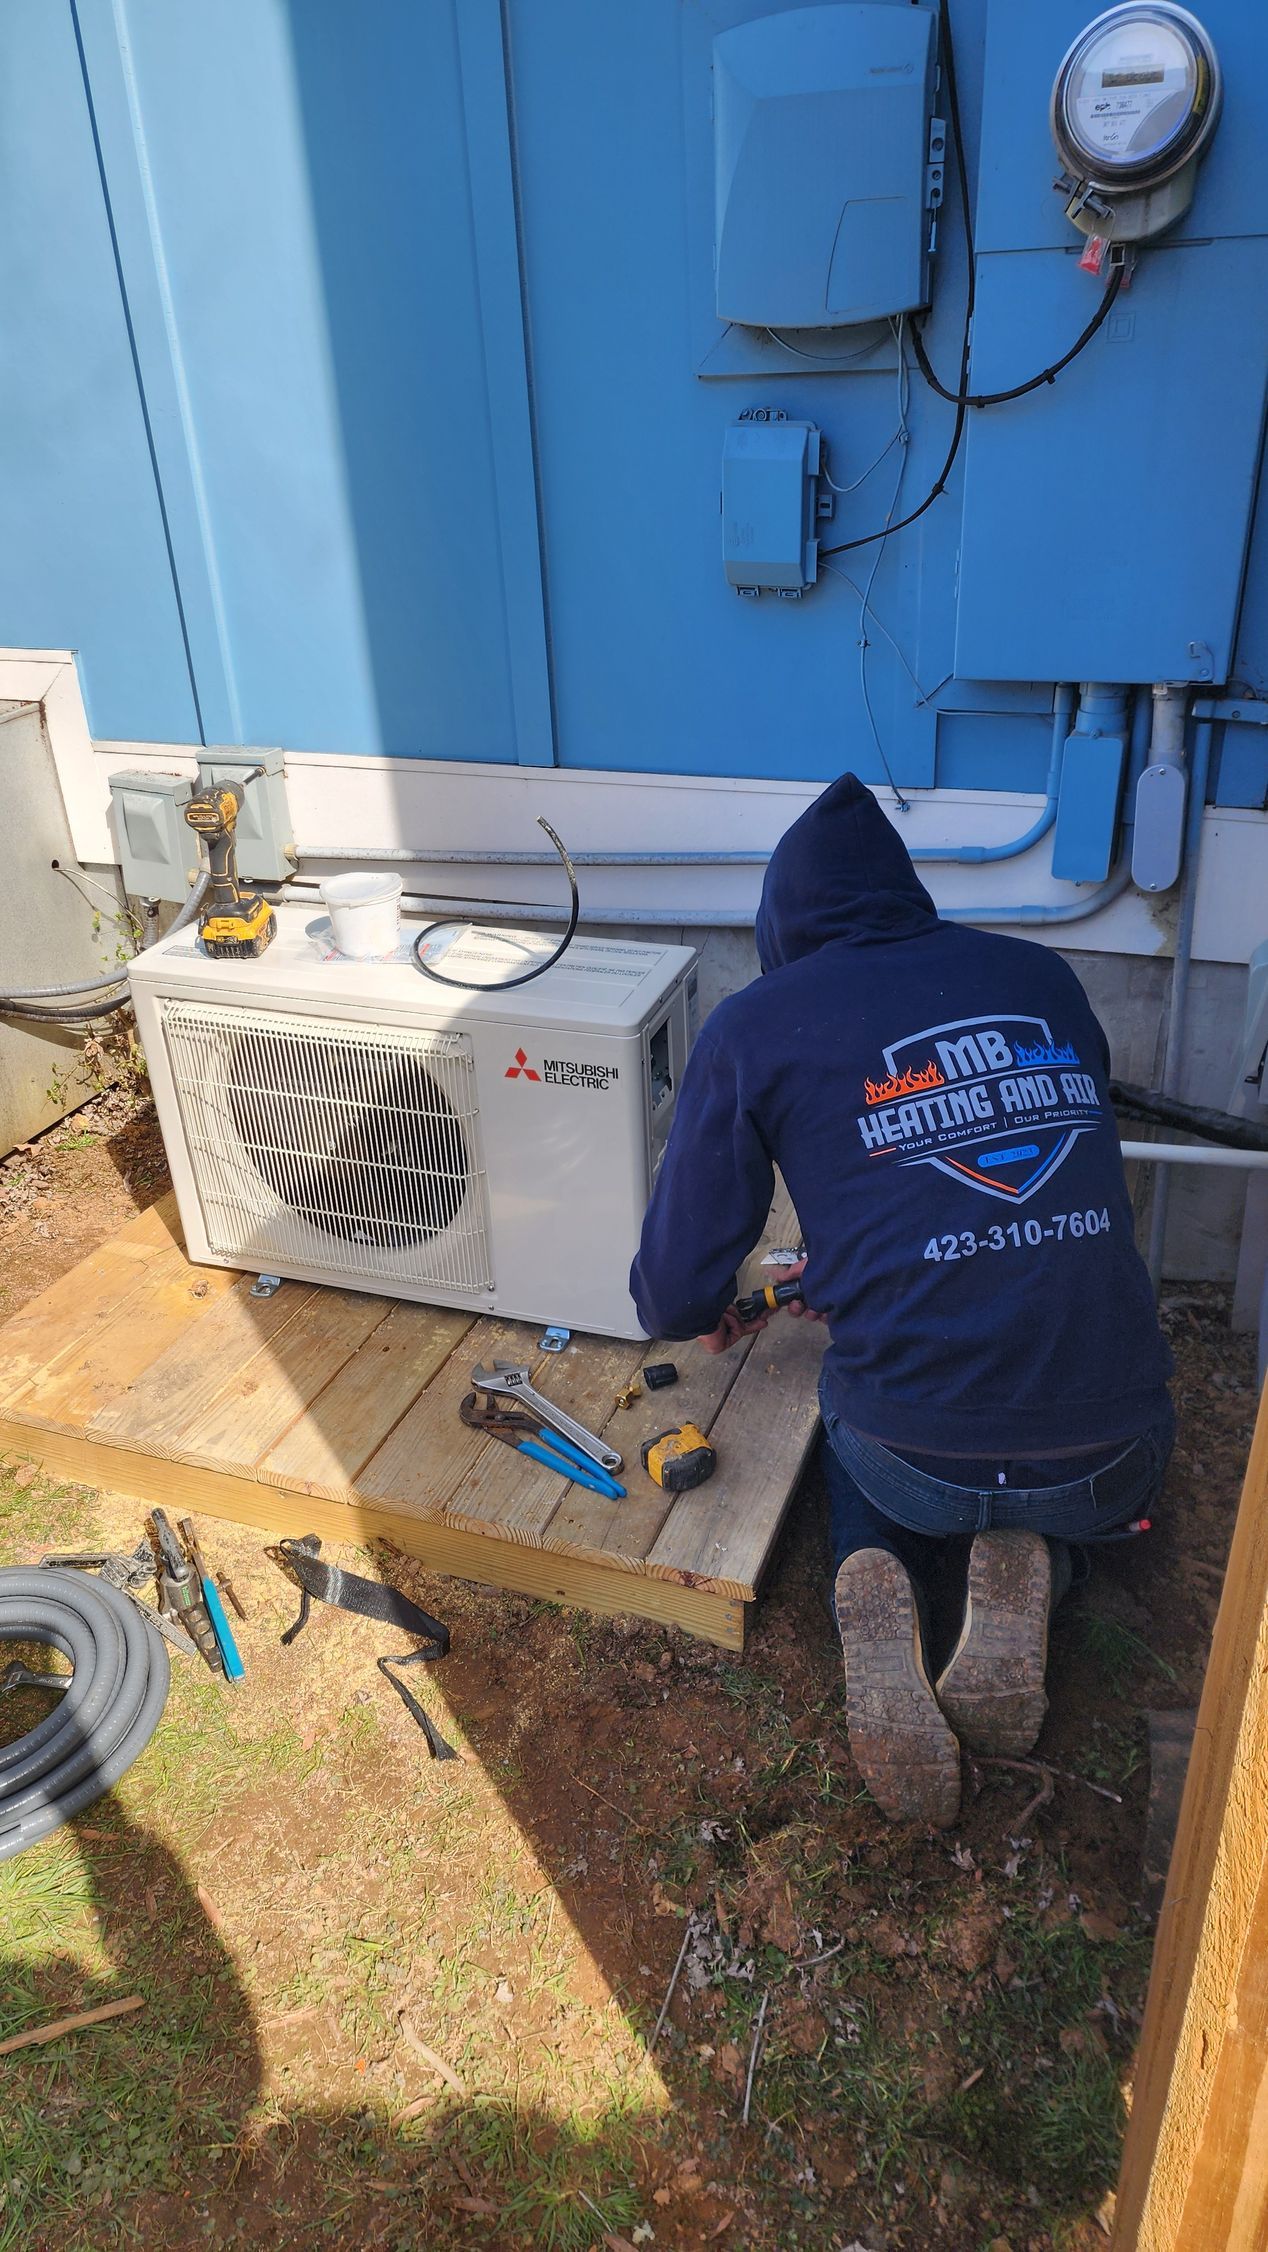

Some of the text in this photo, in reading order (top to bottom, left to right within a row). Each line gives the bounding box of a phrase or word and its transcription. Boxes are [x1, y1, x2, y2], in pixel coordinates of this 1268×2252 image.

[543, 1059, 619, 1080] MITSUBISHI
[935, 1030, 1014, 1081] MB
[544, 1072, 610, 1091] ELECTRIC
[857, 1073, 1101, 1149] HEATING AND AIR
[899, 1109, 1090, 1152] YOUR COMFORT OUR PRIORITY
[923, 1207, 1112, 1263] 423-310-7604
